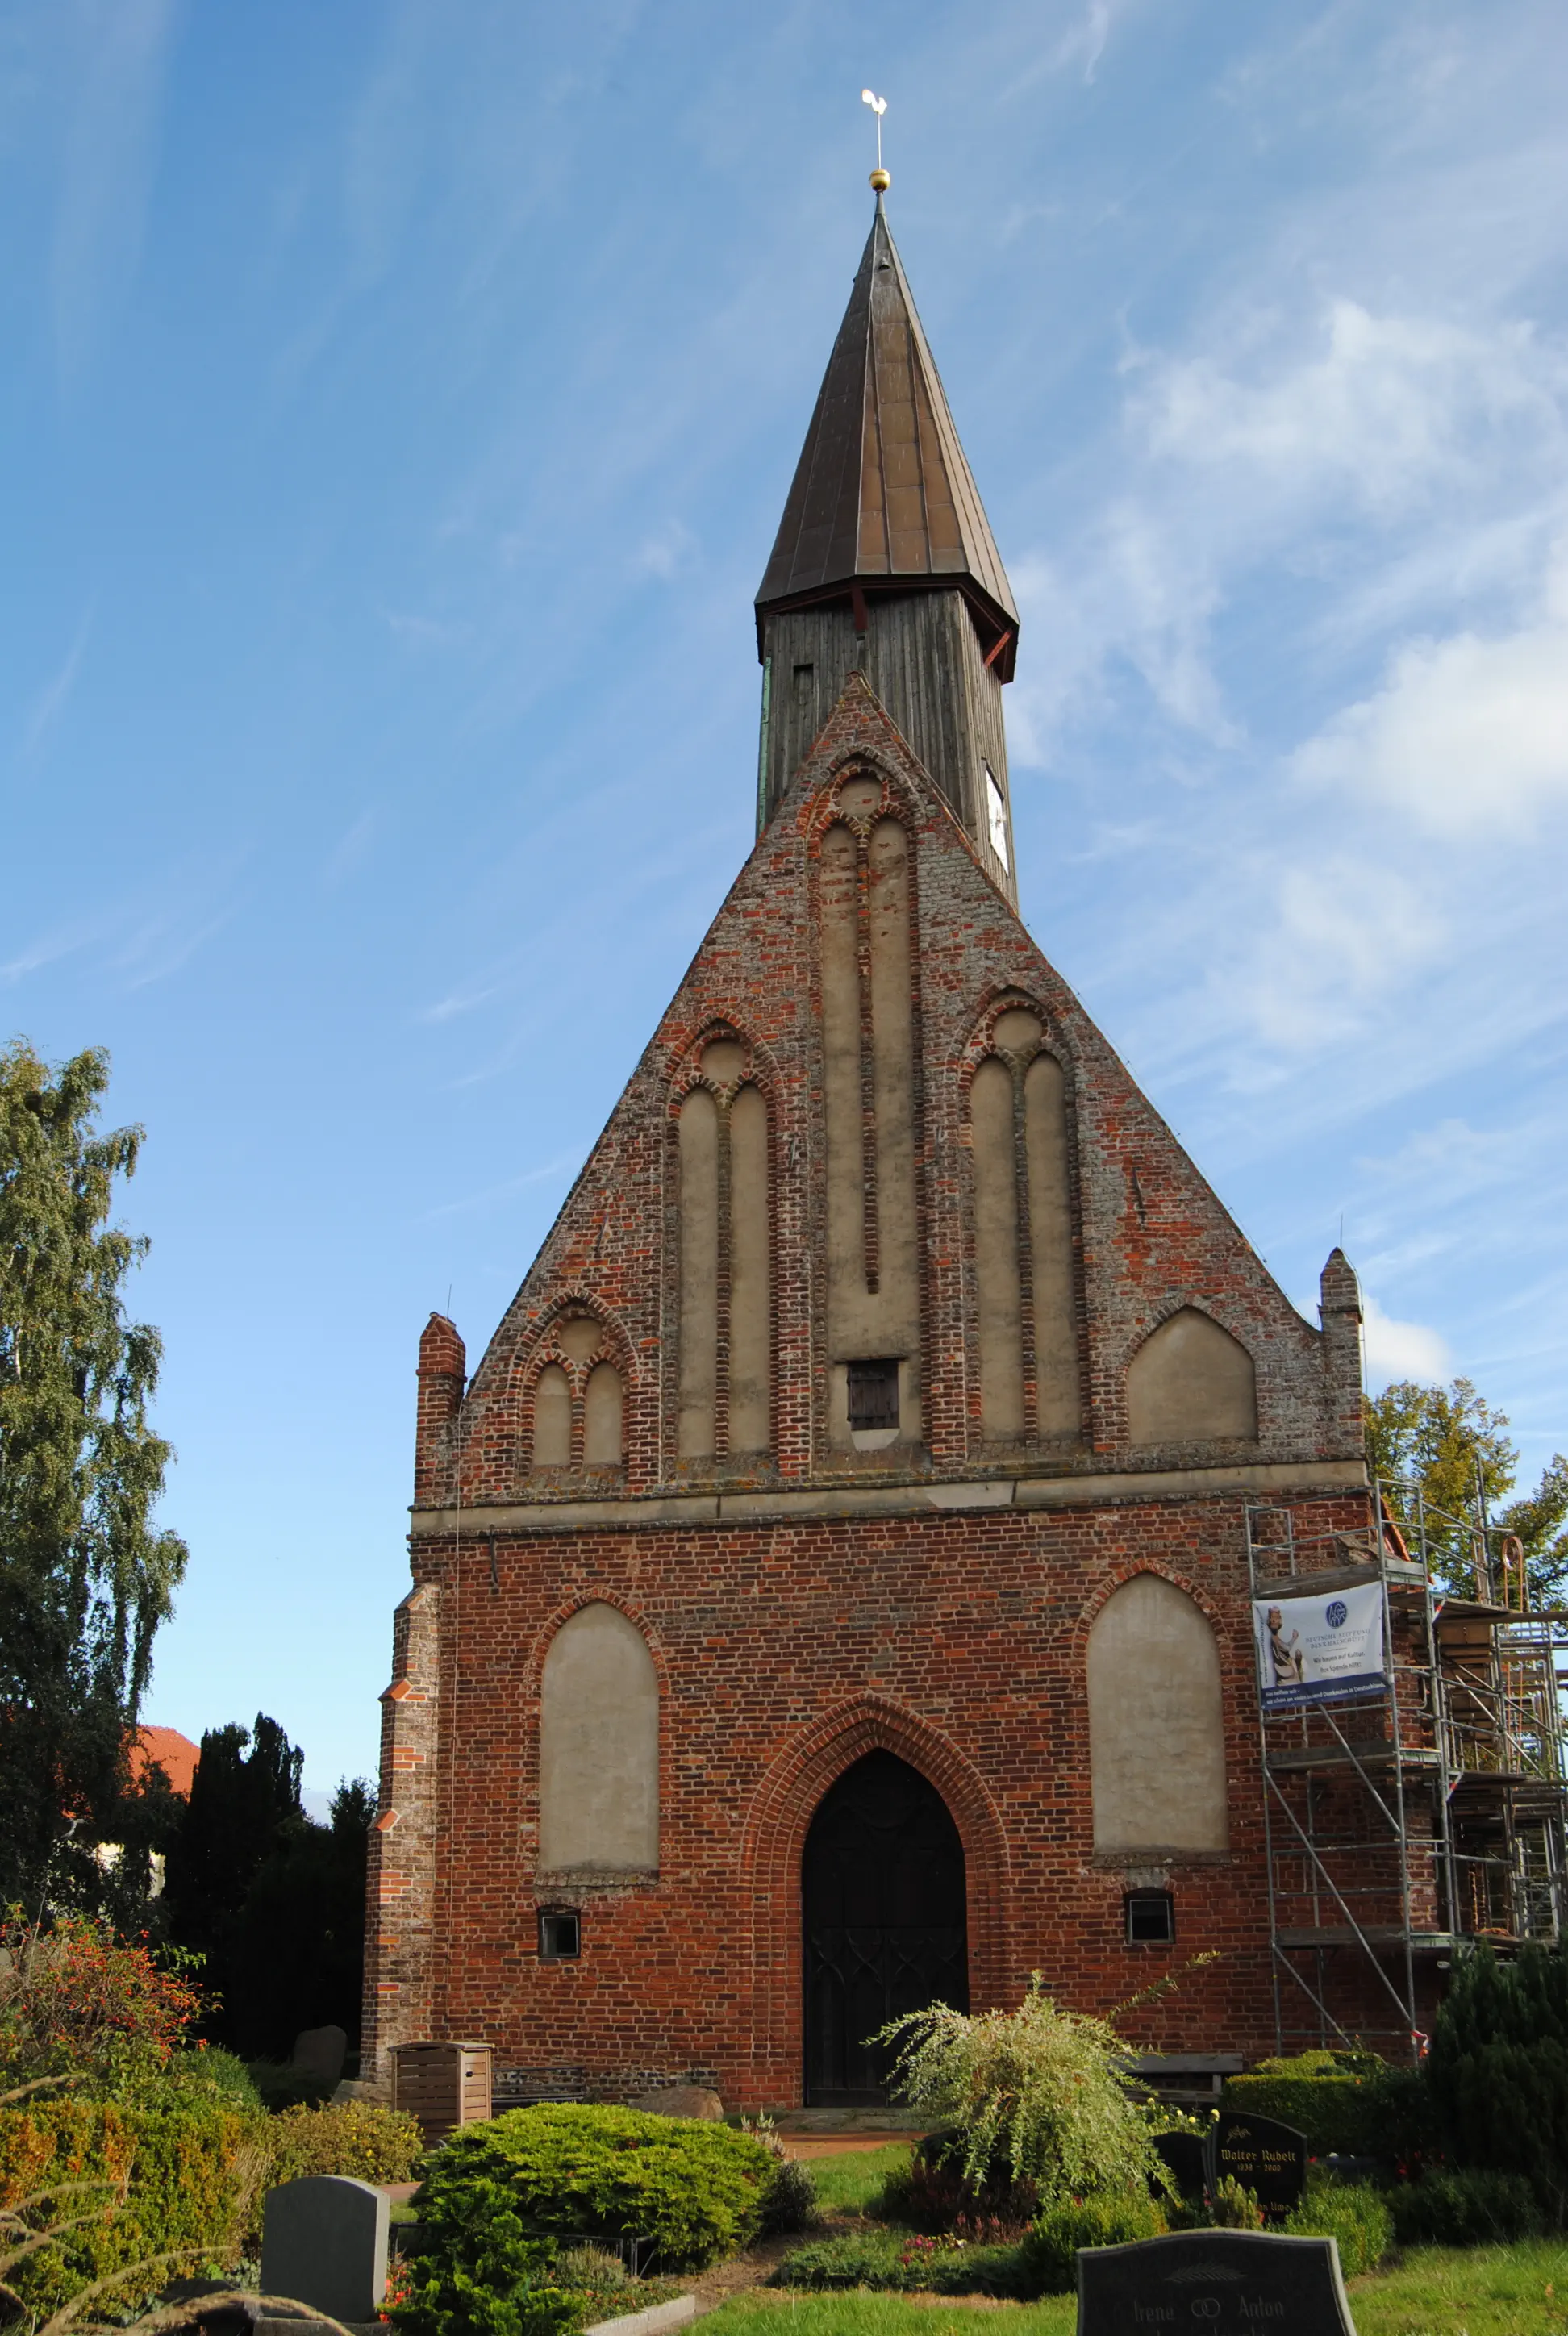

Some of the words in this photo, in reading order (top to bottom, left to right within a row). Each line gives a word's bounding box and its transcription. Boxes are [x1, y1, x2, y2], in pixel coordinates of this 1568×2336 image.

[1321, 1654, 1337, 1662] bauen
[1220, 2149, 1257, 2161] Walter
[1133, 2300, 1175, 2324] Irene
[1238, 2295, 1285, 2319] Anton
